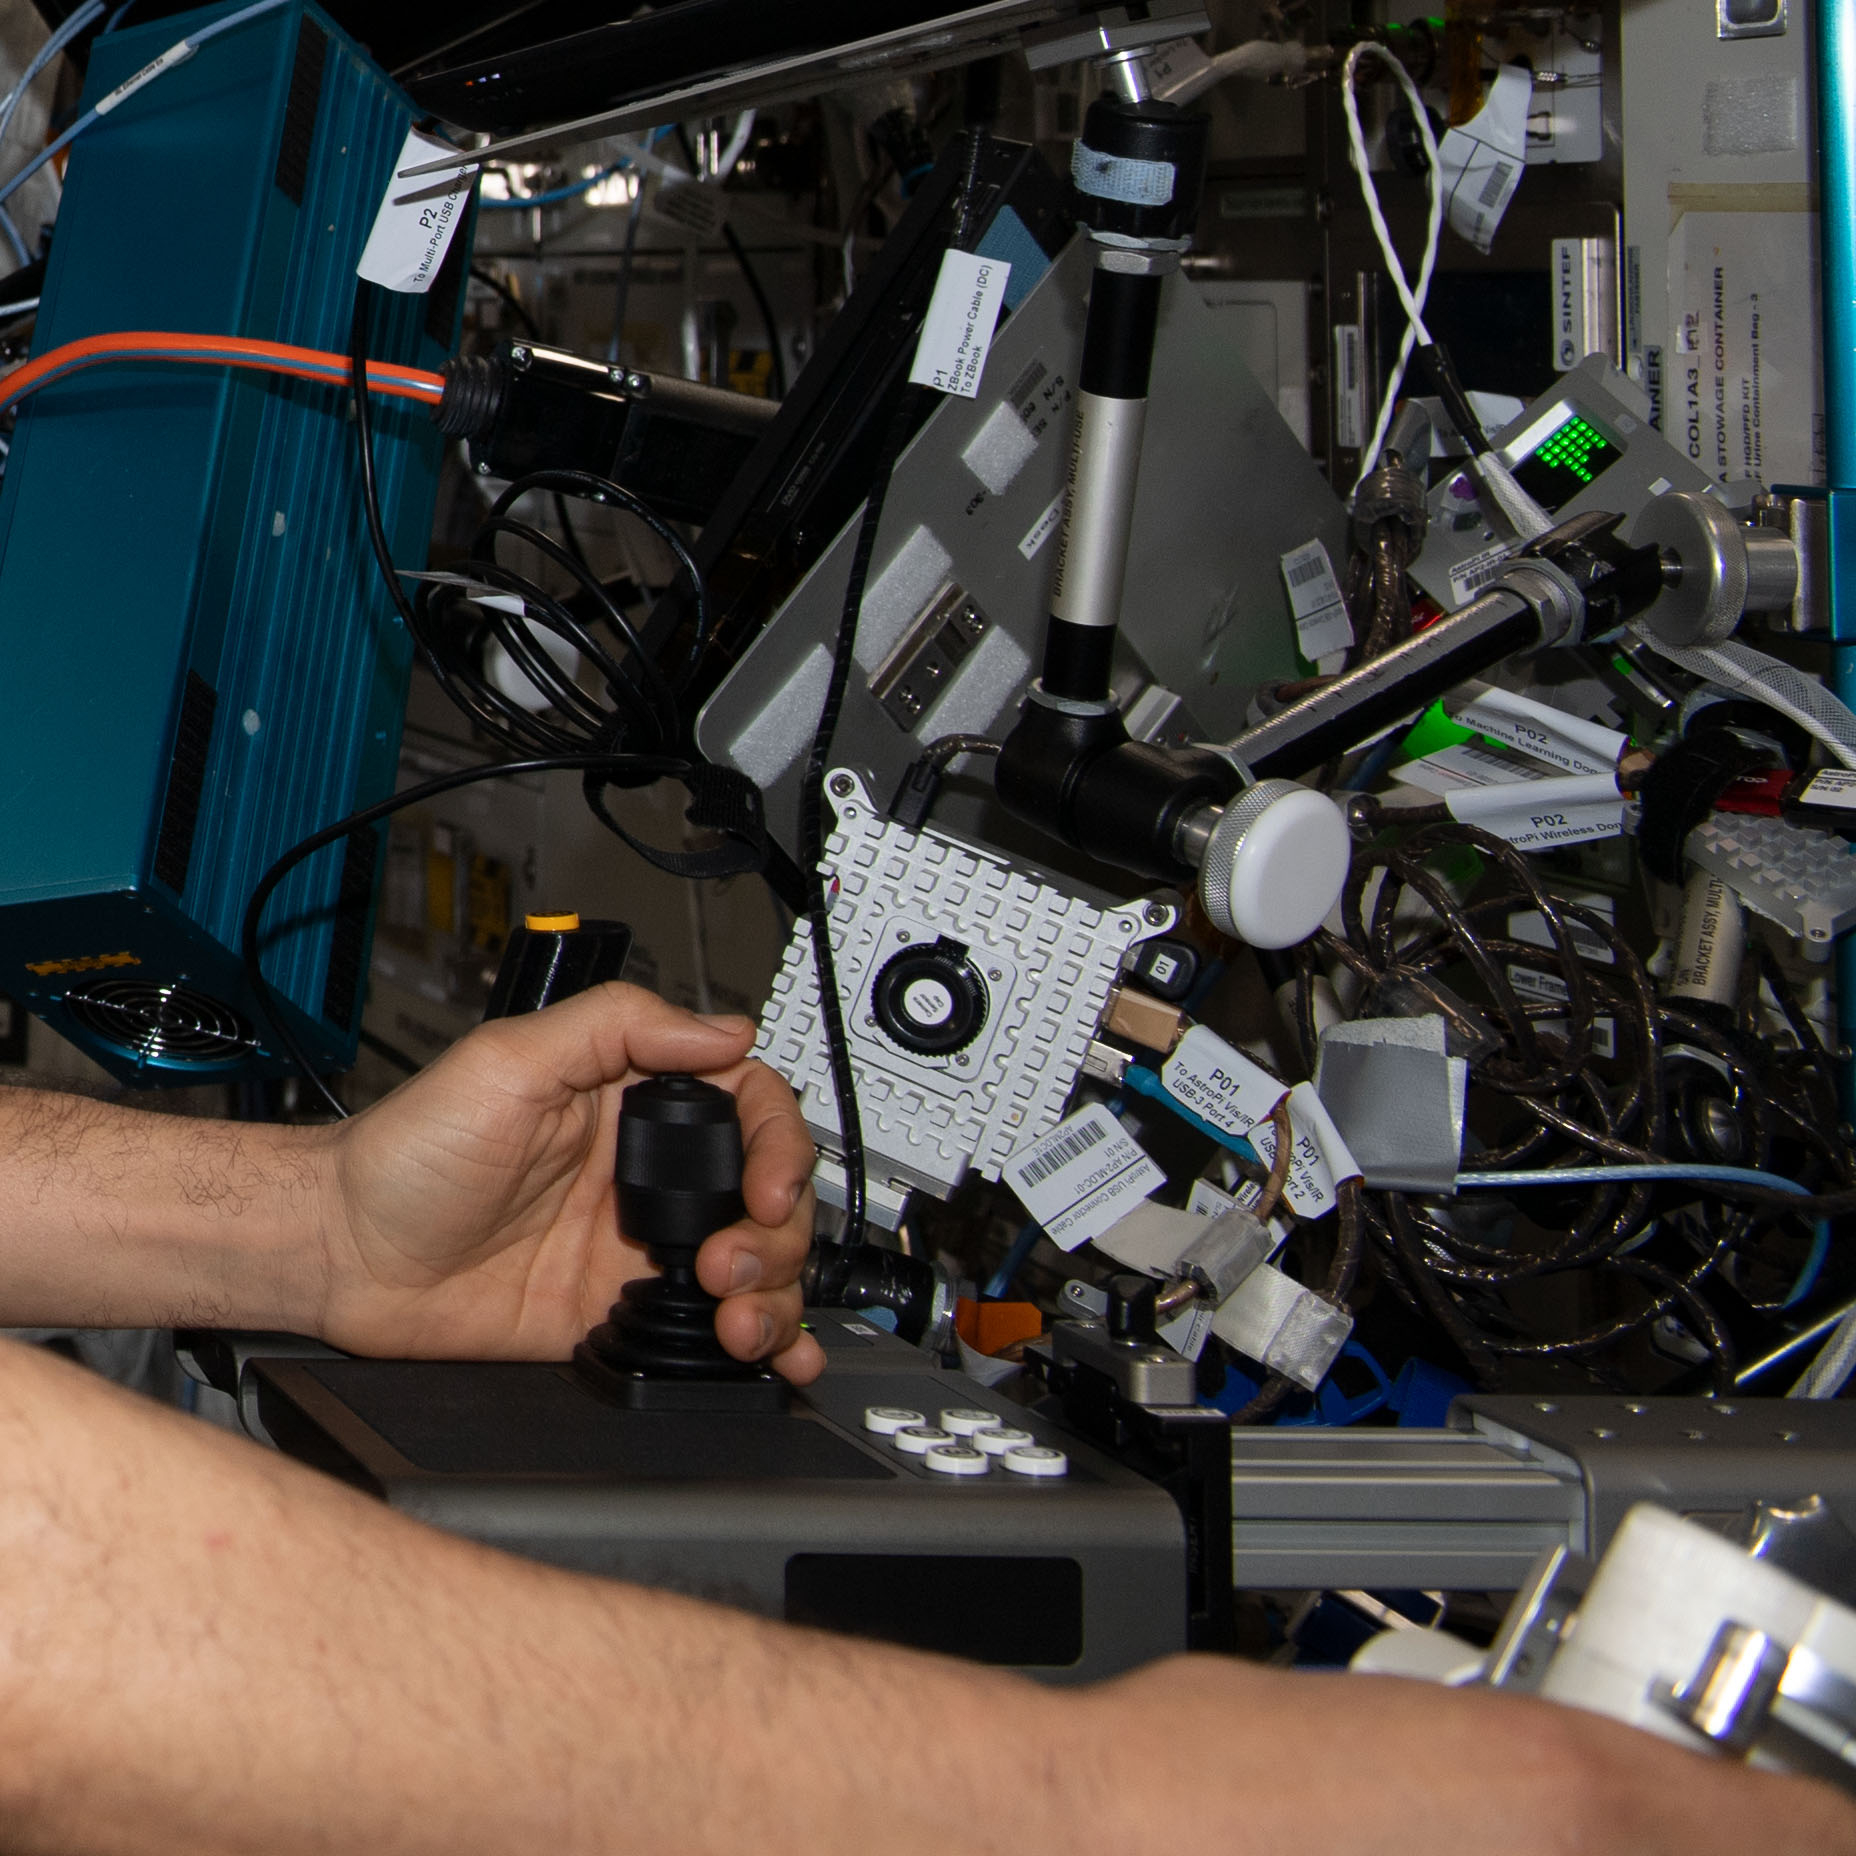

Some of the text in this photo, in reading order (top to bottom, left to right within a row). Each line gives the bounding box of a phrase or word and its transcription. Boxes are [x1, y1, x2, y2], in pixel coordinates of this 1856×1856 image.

[419, 206, 438, 229] P2
[437, 200, 455, 223] USB
[419, 223, 446, 272] Multi-Port
[413, 271, 426, 284] To
[1561, 246, 1572, 333] SINTEF
[946, 262, 993, 391] ZBook Power Cable (DC)
[1751, 313, 1760, 339] Bag
[932, 368, 948, 387] P1
[960, 343, 983, 394] To ZBook
[1714, 266, 1726, 465] STOWAGE CONTAINER
[1751, 343, 1760, 427] Containment
[1741, 377, 1751, 465] HGD/PFD KIT
[1751, 429, 1762, 466] Urine
[1052, 410, 1084, 597] BRACKET ASSY, MULTI-USE
[1024, 507, 1060, 549] Desk
[1465, 716, 1570, 766] Machine Learning
[1512, 723, 1551, 745] P02
[1530, 811, 1567, 829] P02
[1541, 824, 1594, 840] Wireless
[1700, 909, 1719, 937] ASSY,
[1154, 959, 1170, 975] 01
[1692, 936, 1714, 986] BRACKET
[911, 994, 933, 1018] Camera
[918, 992, 938, 1013] Sensor
[931, 993, 945, 1008] Cap
[1173, 1060, 1256, 1129] To AstroPi Vis/IR
[1207, 1067, 1241, 1098] P01
[1171, 1077, 1234, 1129] USB-3 Port 4
[1103, 1136, 1128, 1157] S/N 01
[1294, 1136, 1321, 1168] P01
[1073, 1146, 1136, 1195] P/N AP2-MLDC-01
[1050, 1162, 1150, 1236] AstroPi USB Connector Cable
[1283, 1173, 1299, 1191] ort
[1292, 1190, 1305, 1200] 2
[1299, 1172, 1323, 1202] Vis/IR
